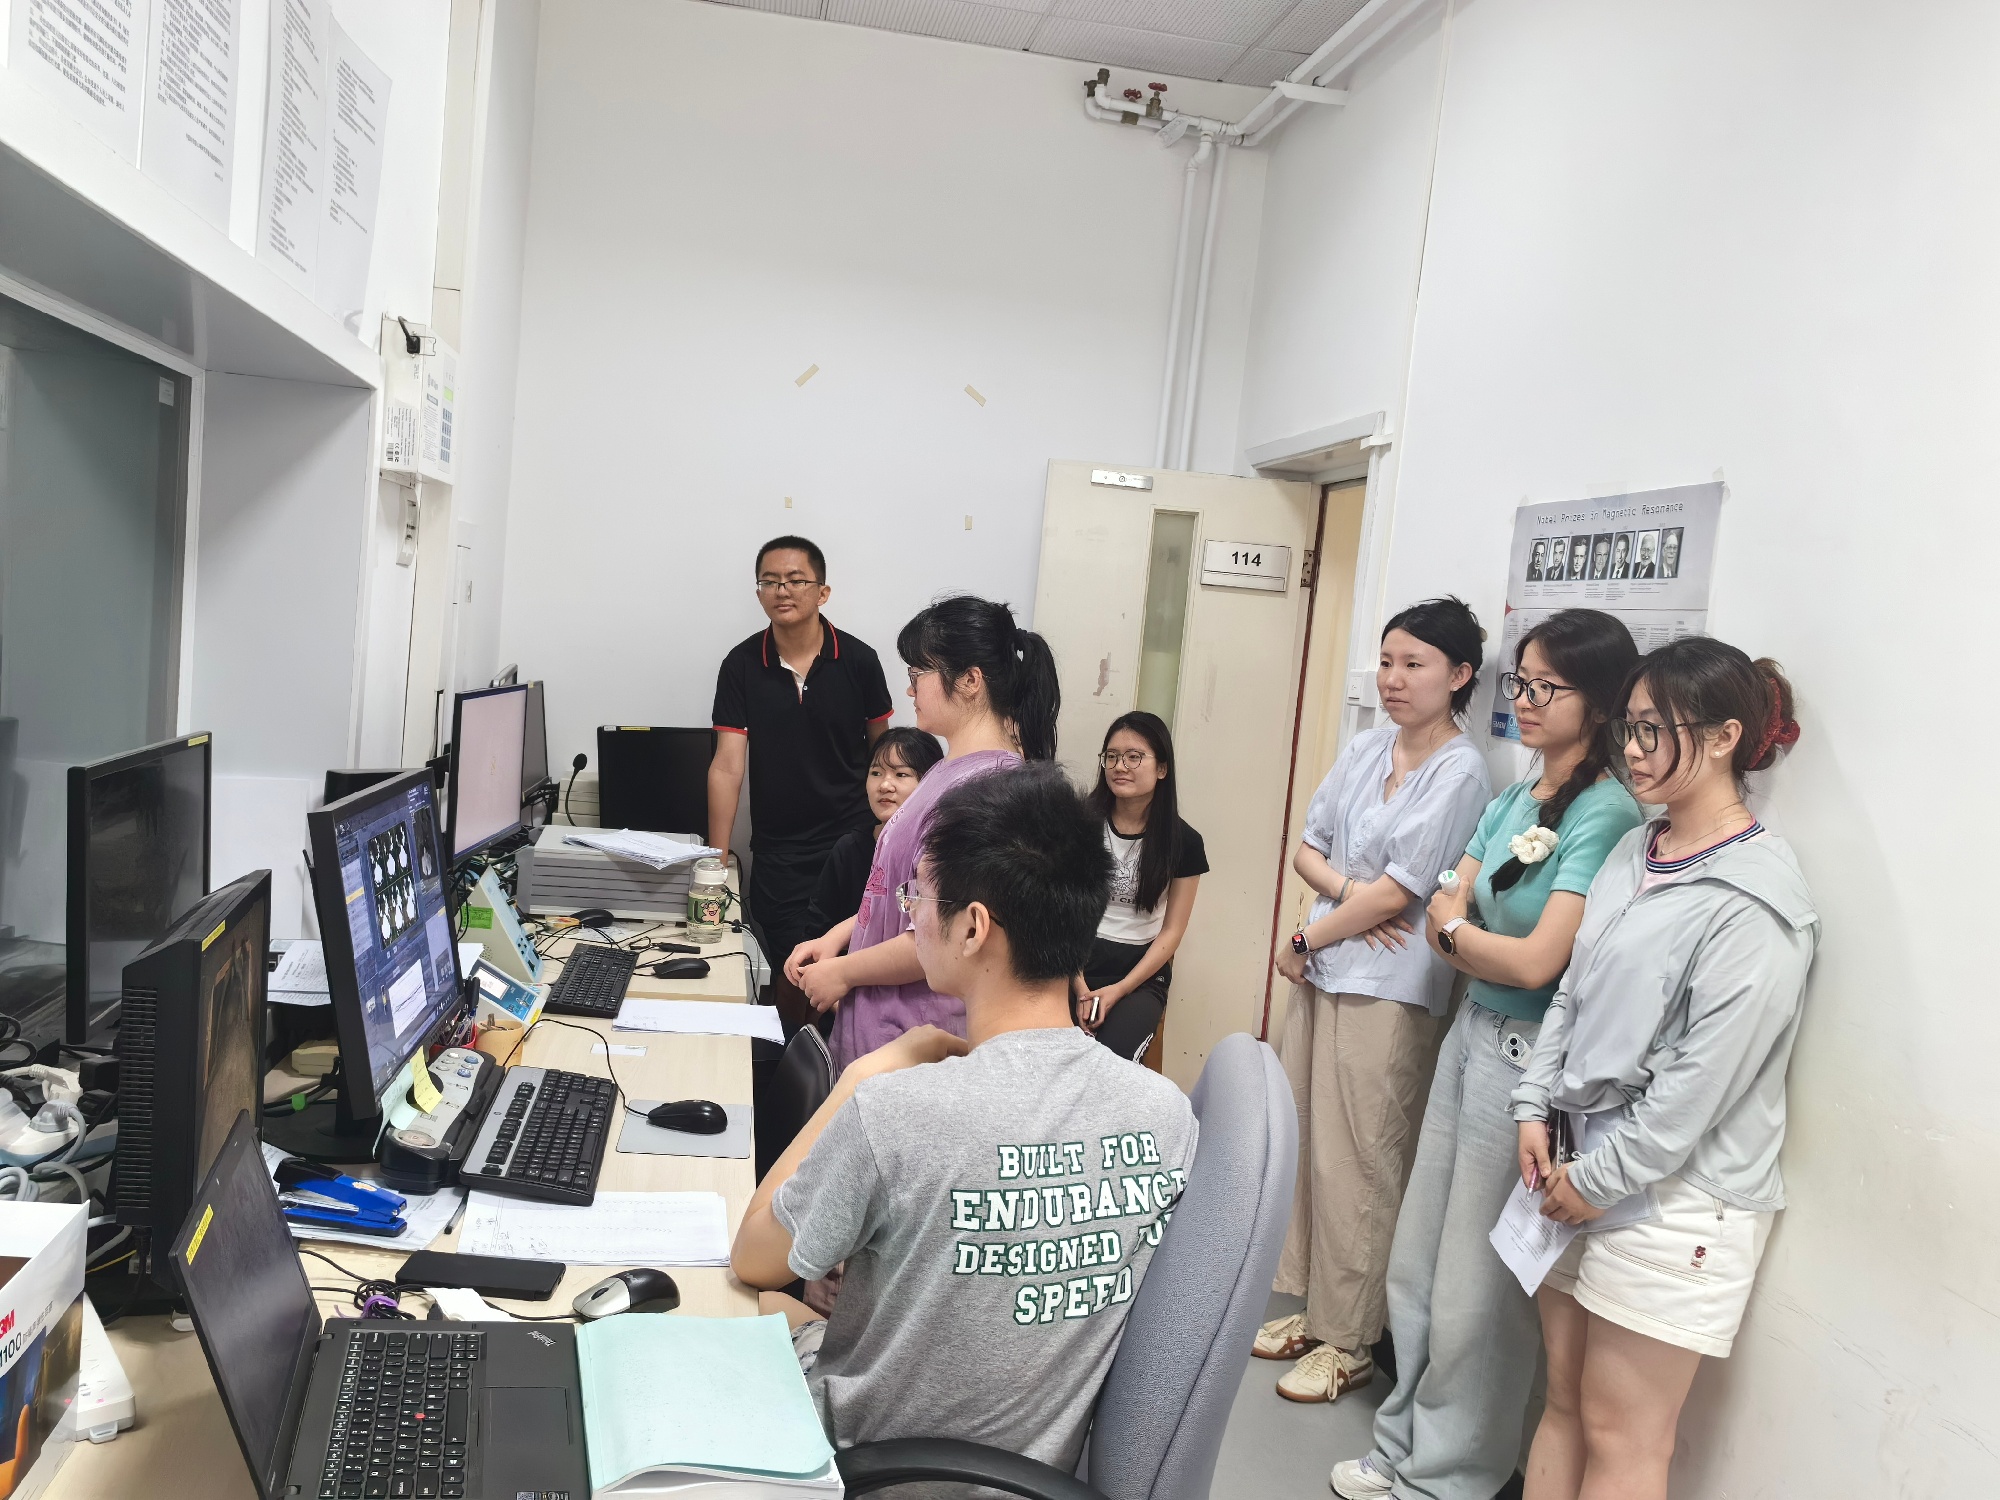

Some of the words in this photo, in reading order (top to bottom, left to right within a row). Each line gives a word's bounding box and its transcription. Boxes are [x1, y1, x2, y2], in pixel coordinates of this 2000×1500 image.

[1537, 514, 1556, 525] Nobel
[1561, 512, 1585, 523] Prizes
[1590, 510, 1598, 520] in
[1603, 507, 1637, 521] Magnetic
[1642, 502, 1684, 516] Resonance
[1231, 551, 1262, 567] 114
[997, 1142, 1084, 1180] BUILT
[1100, 1131, 1161, 1170] FOR
[953, 1230, 1122, 1277] DESIGNED
[1013, 1265, 1133, 1325] SPEED
[0, 1309, 15, 1339] 3M
